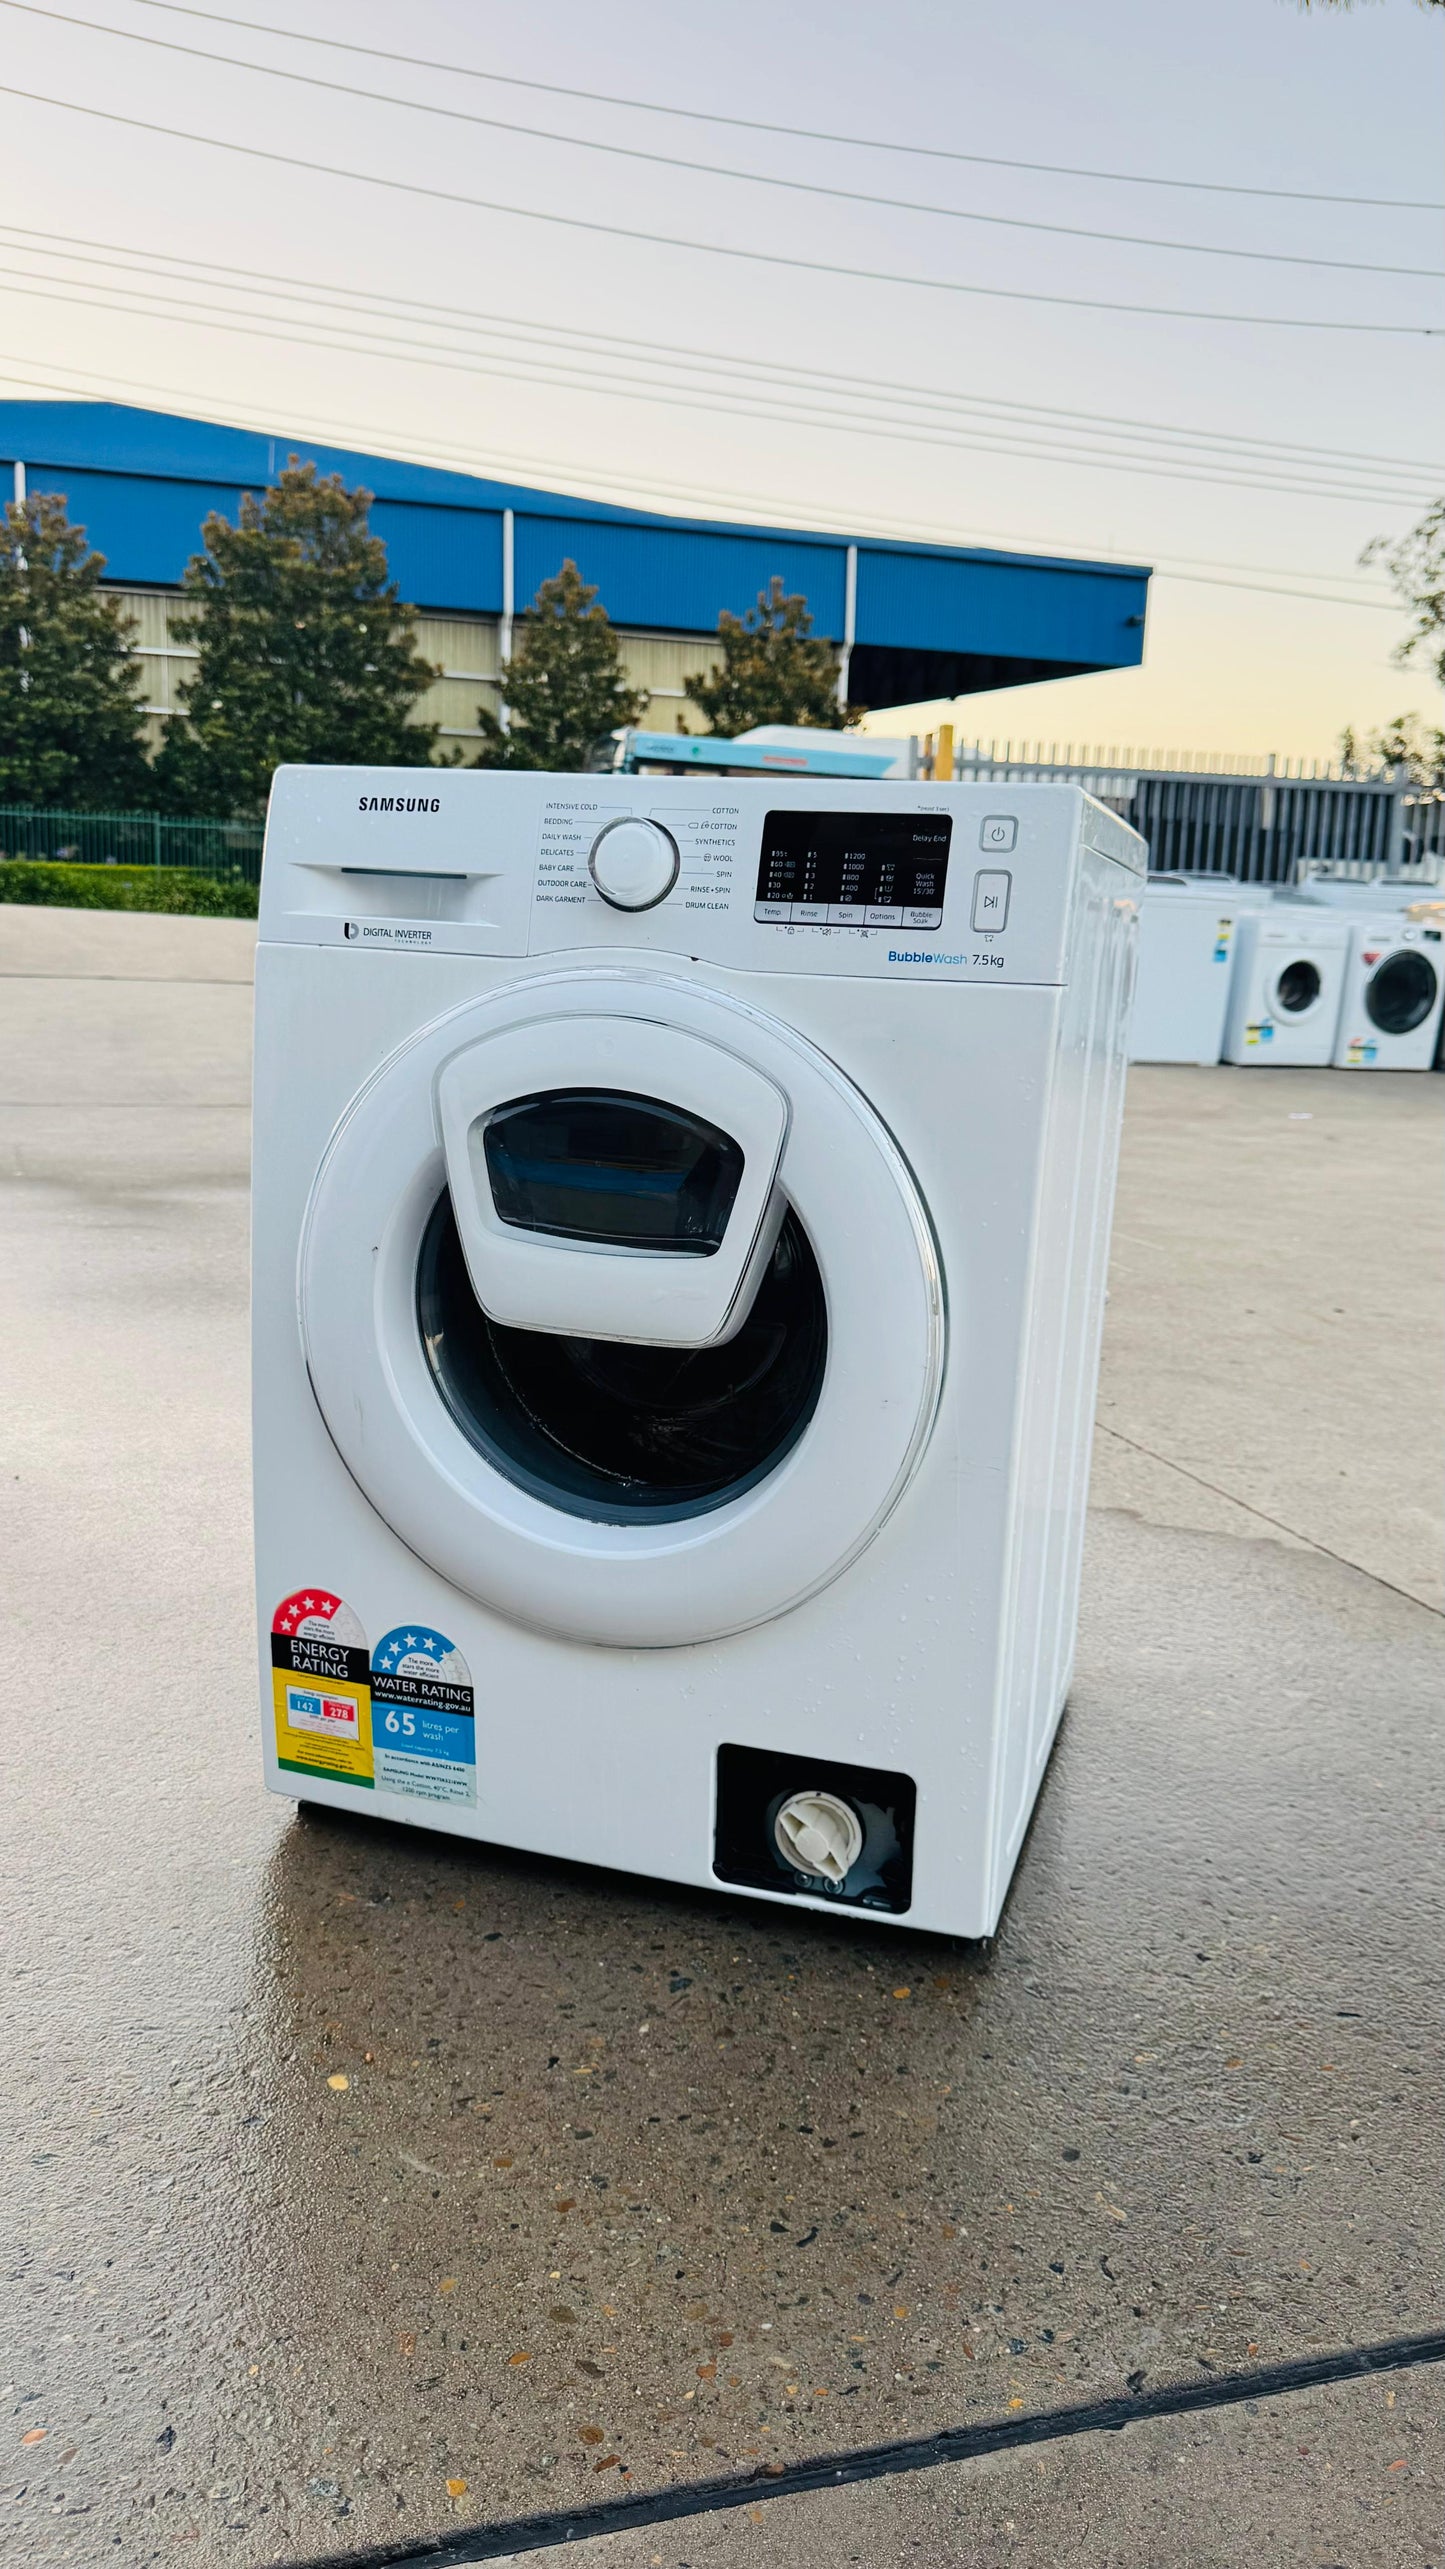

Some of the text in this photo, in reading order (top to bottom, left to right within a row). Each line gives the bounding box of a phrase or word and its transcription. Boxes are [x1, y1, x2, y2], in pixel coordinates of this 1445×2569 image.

[359, 797, 440, 812] SAMSUNG
[695, 838, 736, 846] SYNTHETICS
[912, 834, 932, 843] Delay
[685, 901, 729, 910] DRUM CLEAN
[870, 912, 896, 921] Options
[363, 928, 432, 940] DIGITAL INVERTER
[888, 951, 1004, 968] BubbleWash 7.5kg
[290, 1639, 349, 1662] ENERGY
[292, 1655, 348, 1678] RATING
[373, 1676, 471, 1702] WATER RATING
[296, 1700, 313, 1712] 142
[374, 1690, 471, 1712] www.waterrating.gov.au
[329, 1707, 349, 1719] 278
[385, 1710, 416, 1736] 65
[422, 1720, 459, 1735] litres per
[422, 1731, 444, 1741] wash
[383, 1766, 409, 1776] SAMSUNG
